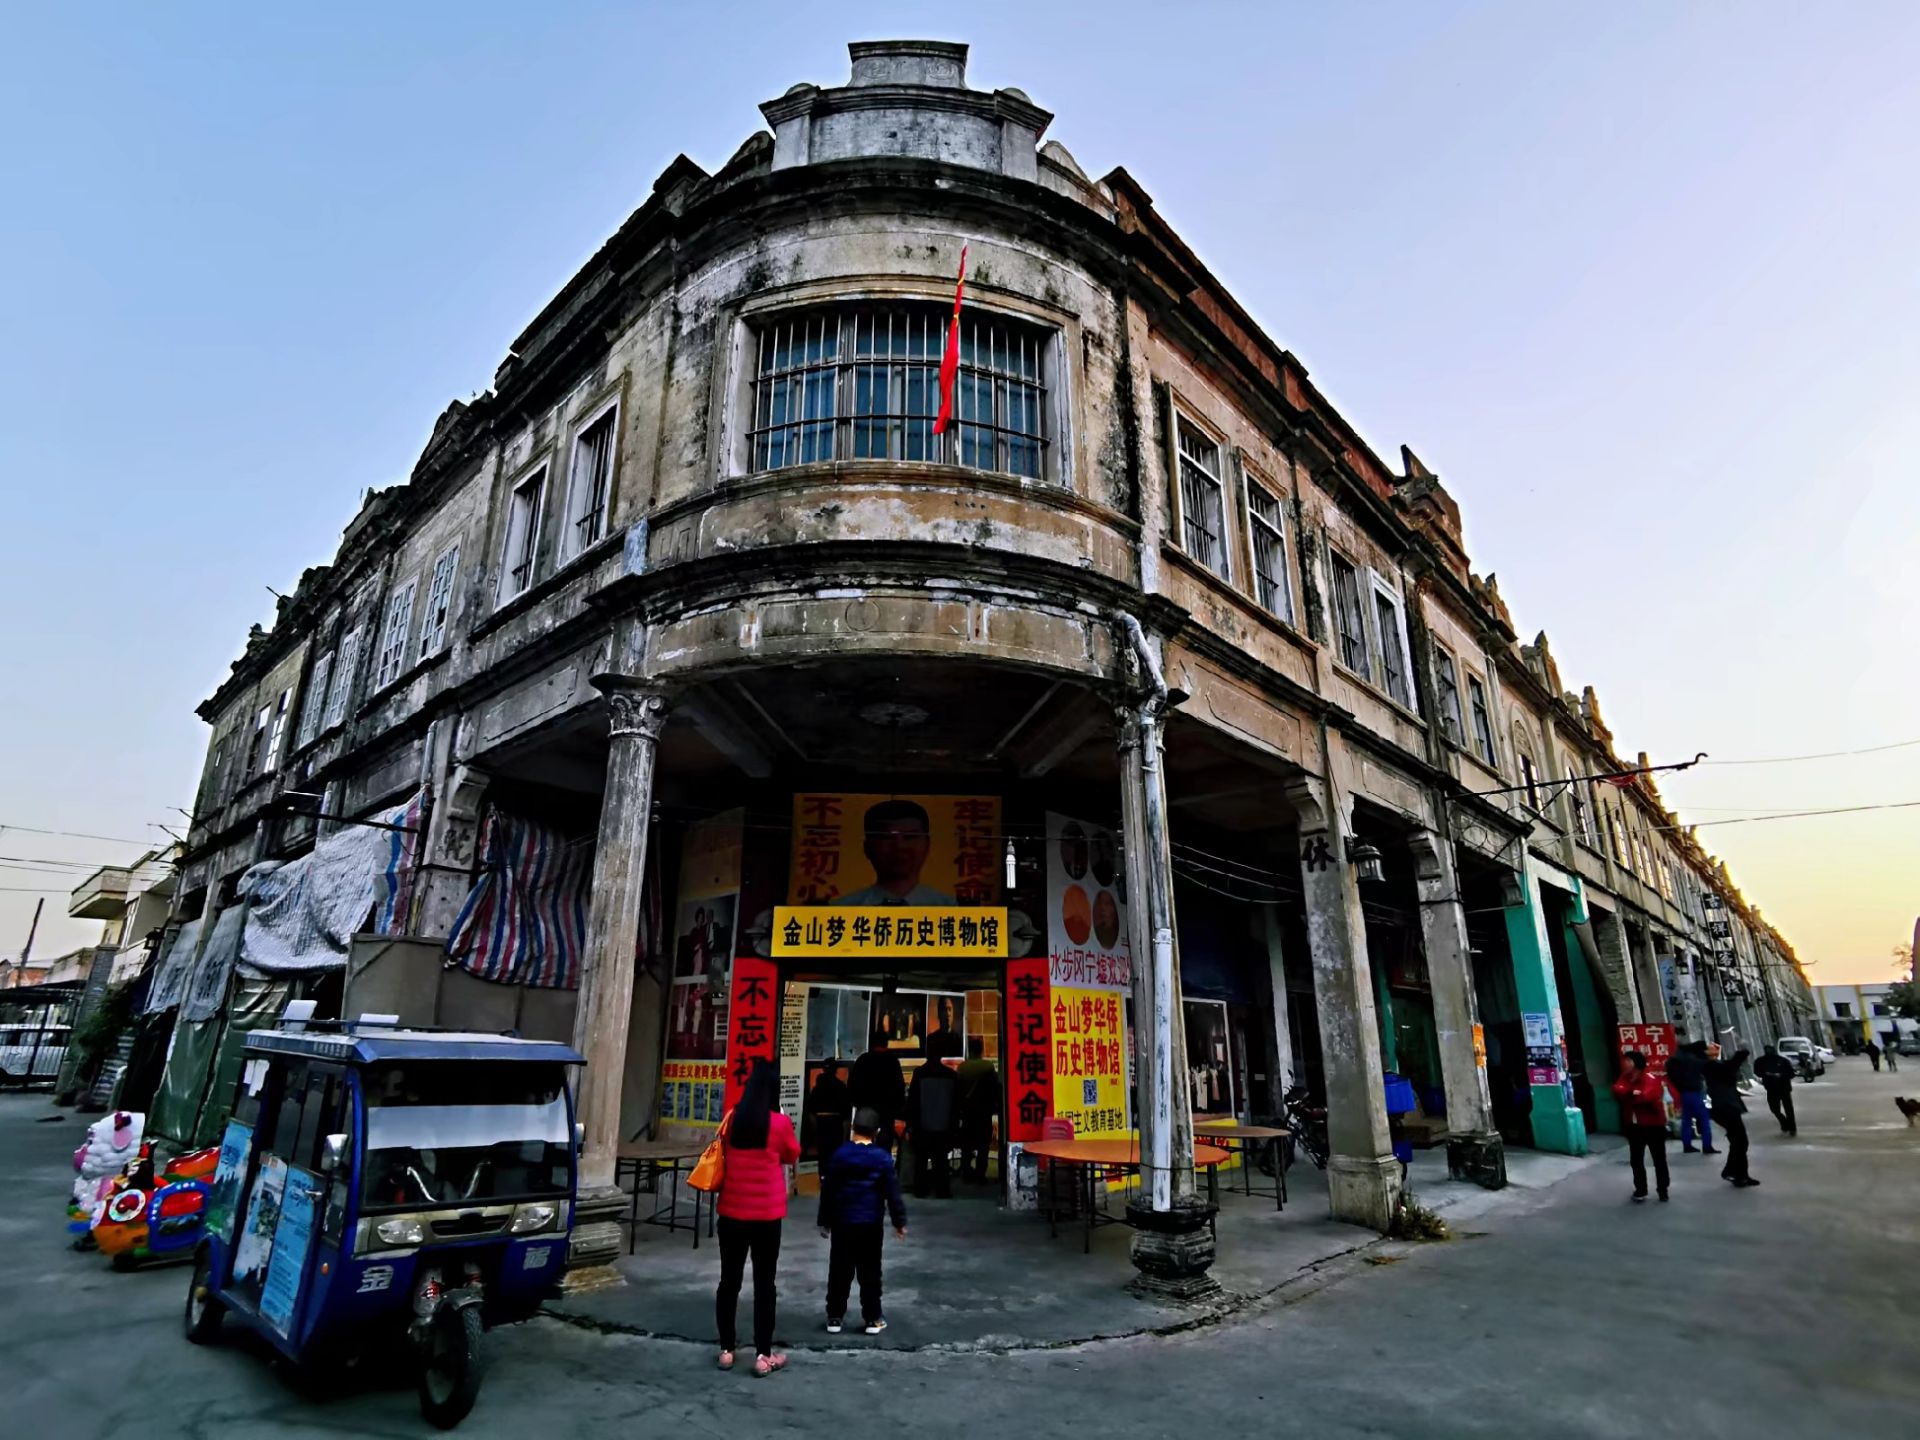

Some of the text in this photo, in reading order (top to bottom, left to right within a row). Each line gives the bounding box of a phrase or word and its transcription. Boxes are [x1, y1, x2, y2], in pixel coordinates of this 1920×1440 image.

[783, 916, 998, 947] 金山梦华侨历史博物馆
[1050, 946, 1131, 987] 水步冈宁墟欢迎
[1054, 997, 1118, 1035] 金山梦华侨
[1013, 973, 1048, 1125] 牢记使命
[1056, 1038, 1120, 1076] 历史博物馆
